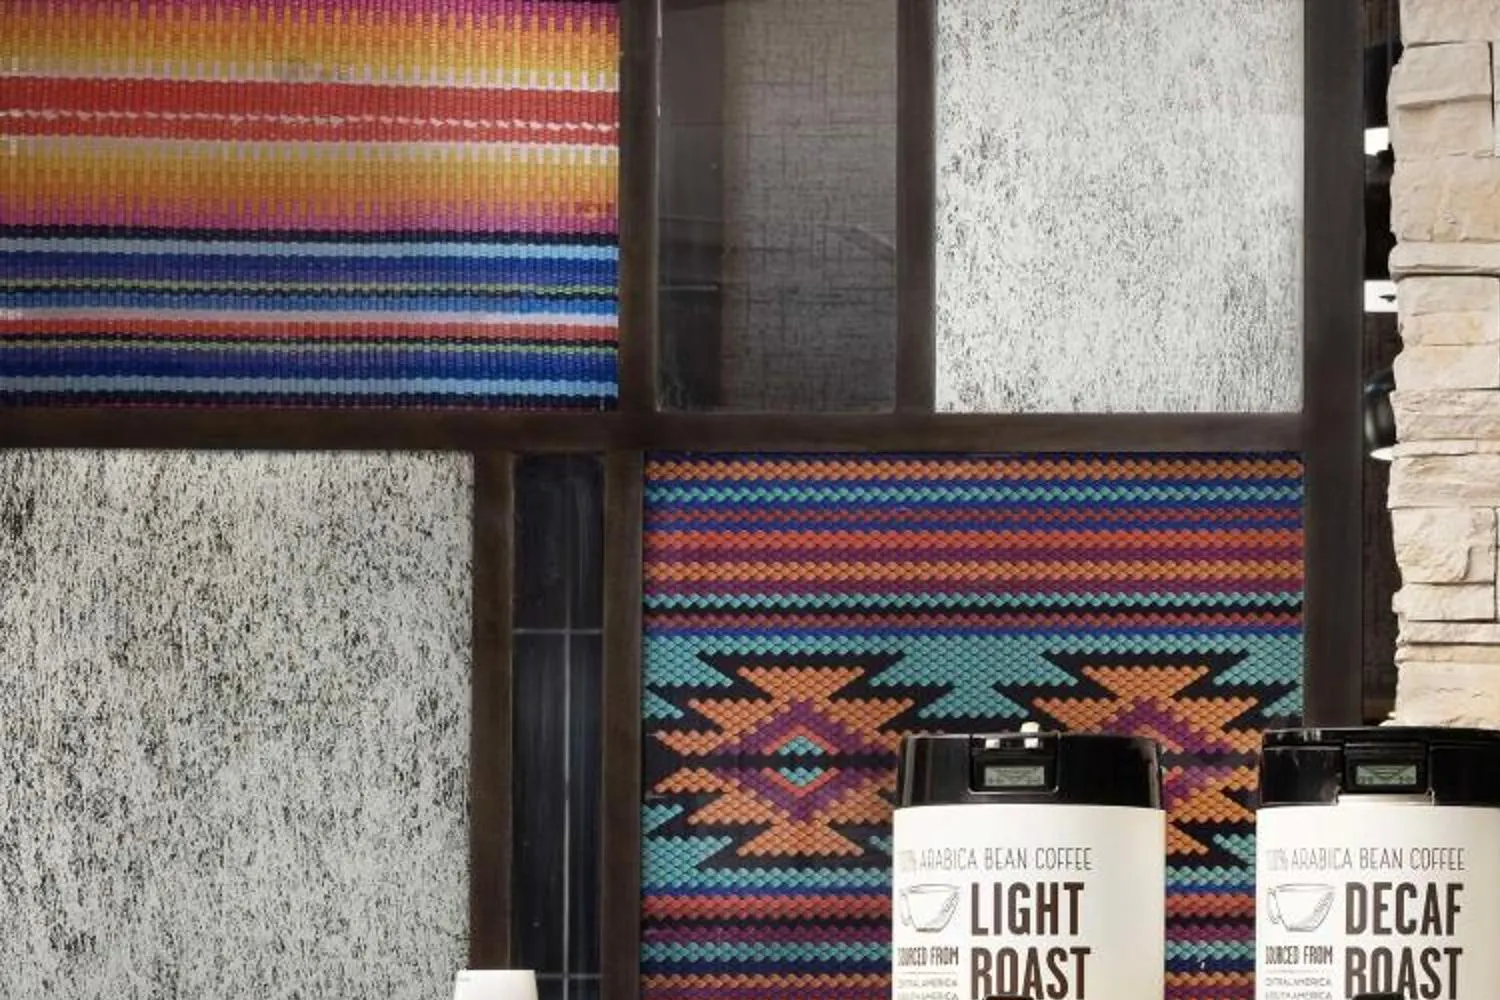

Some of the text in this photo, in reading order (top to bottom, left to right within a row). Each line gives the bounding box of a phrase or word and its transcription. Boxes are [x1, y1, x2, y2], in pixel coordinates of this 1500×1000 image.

[919, 847, 977, 871] ARABICA
[984, 847, 1027, 871] BEAN
[1035, 847, 1093, 871] COFFEE
[1291, 848, 1353, 870] ARABICA
[1359, 847, 1404, 870] BEAN
[1410, 847, 1466, 871] COFFEE
[971, 882, 1084, 936] LIGHT
[1345, 882, 1464, 936] DECAF
[930, 946, 958, 967] FROM
[970, 946, 1091, 1000] ROAST
[1303, 945, 1333, 965] FROM
[1345, 946, 1464, 1000] ROAST
